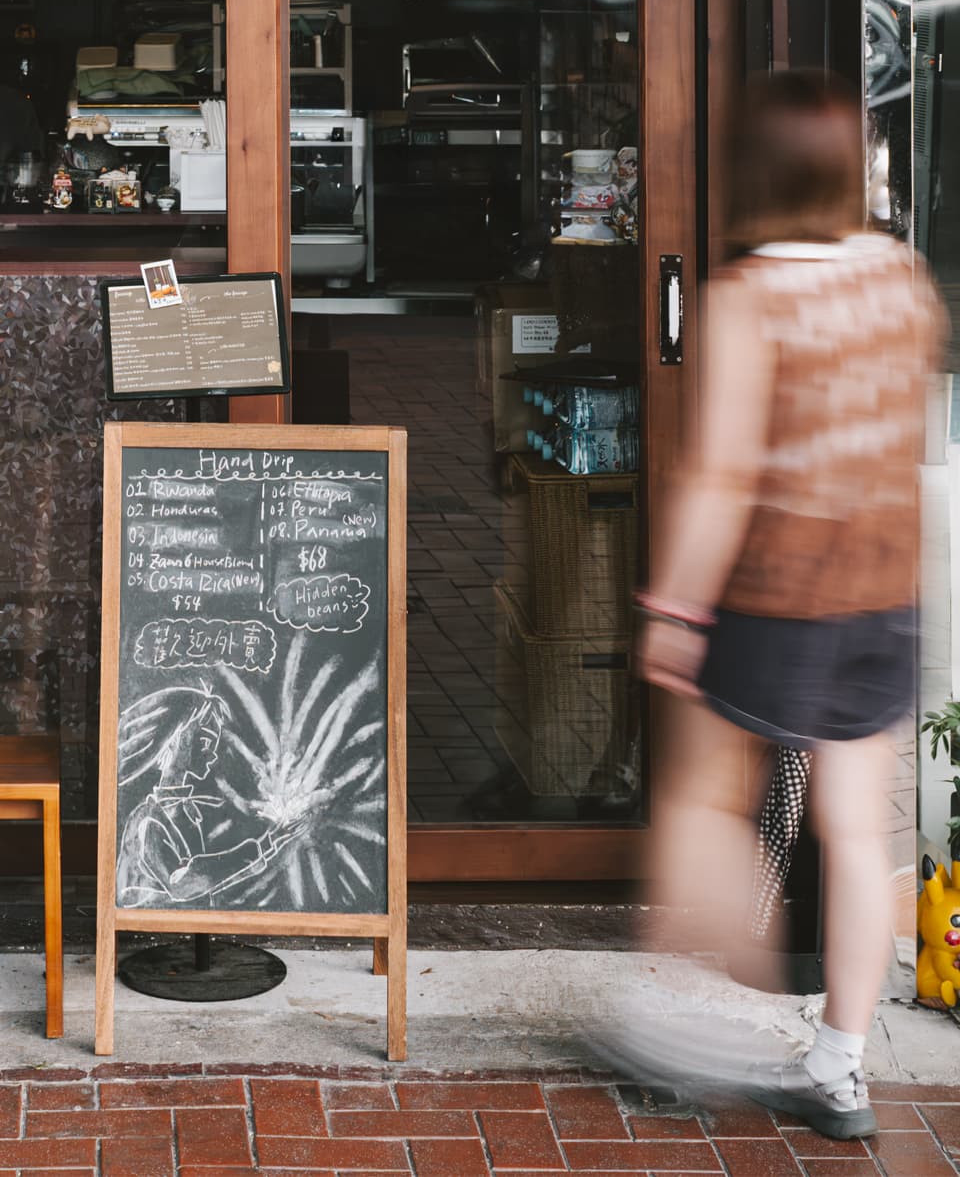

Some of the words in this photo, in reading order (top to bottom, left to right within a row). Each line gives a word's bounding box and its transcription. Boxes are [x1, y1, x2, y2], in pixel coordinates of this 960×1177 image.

[200, 449, 254, 471] Hand
[262, 451, 294, 473] Drip
[153, 479, 215, 499] Rwanda
[152, 503, 218, 517] Honduras
[291, 499, 327, 518] Peru
[295, 518, 366, 540] Panama
[343, 511, 377, 528] (New)
[297, 544, 327, 572] $68
[149, 570, 194, 592] Costa
[172, 594, 201, 611] $54
[296, 583, 347, 605] Hidden
[307, 601, 348, 618] beans
